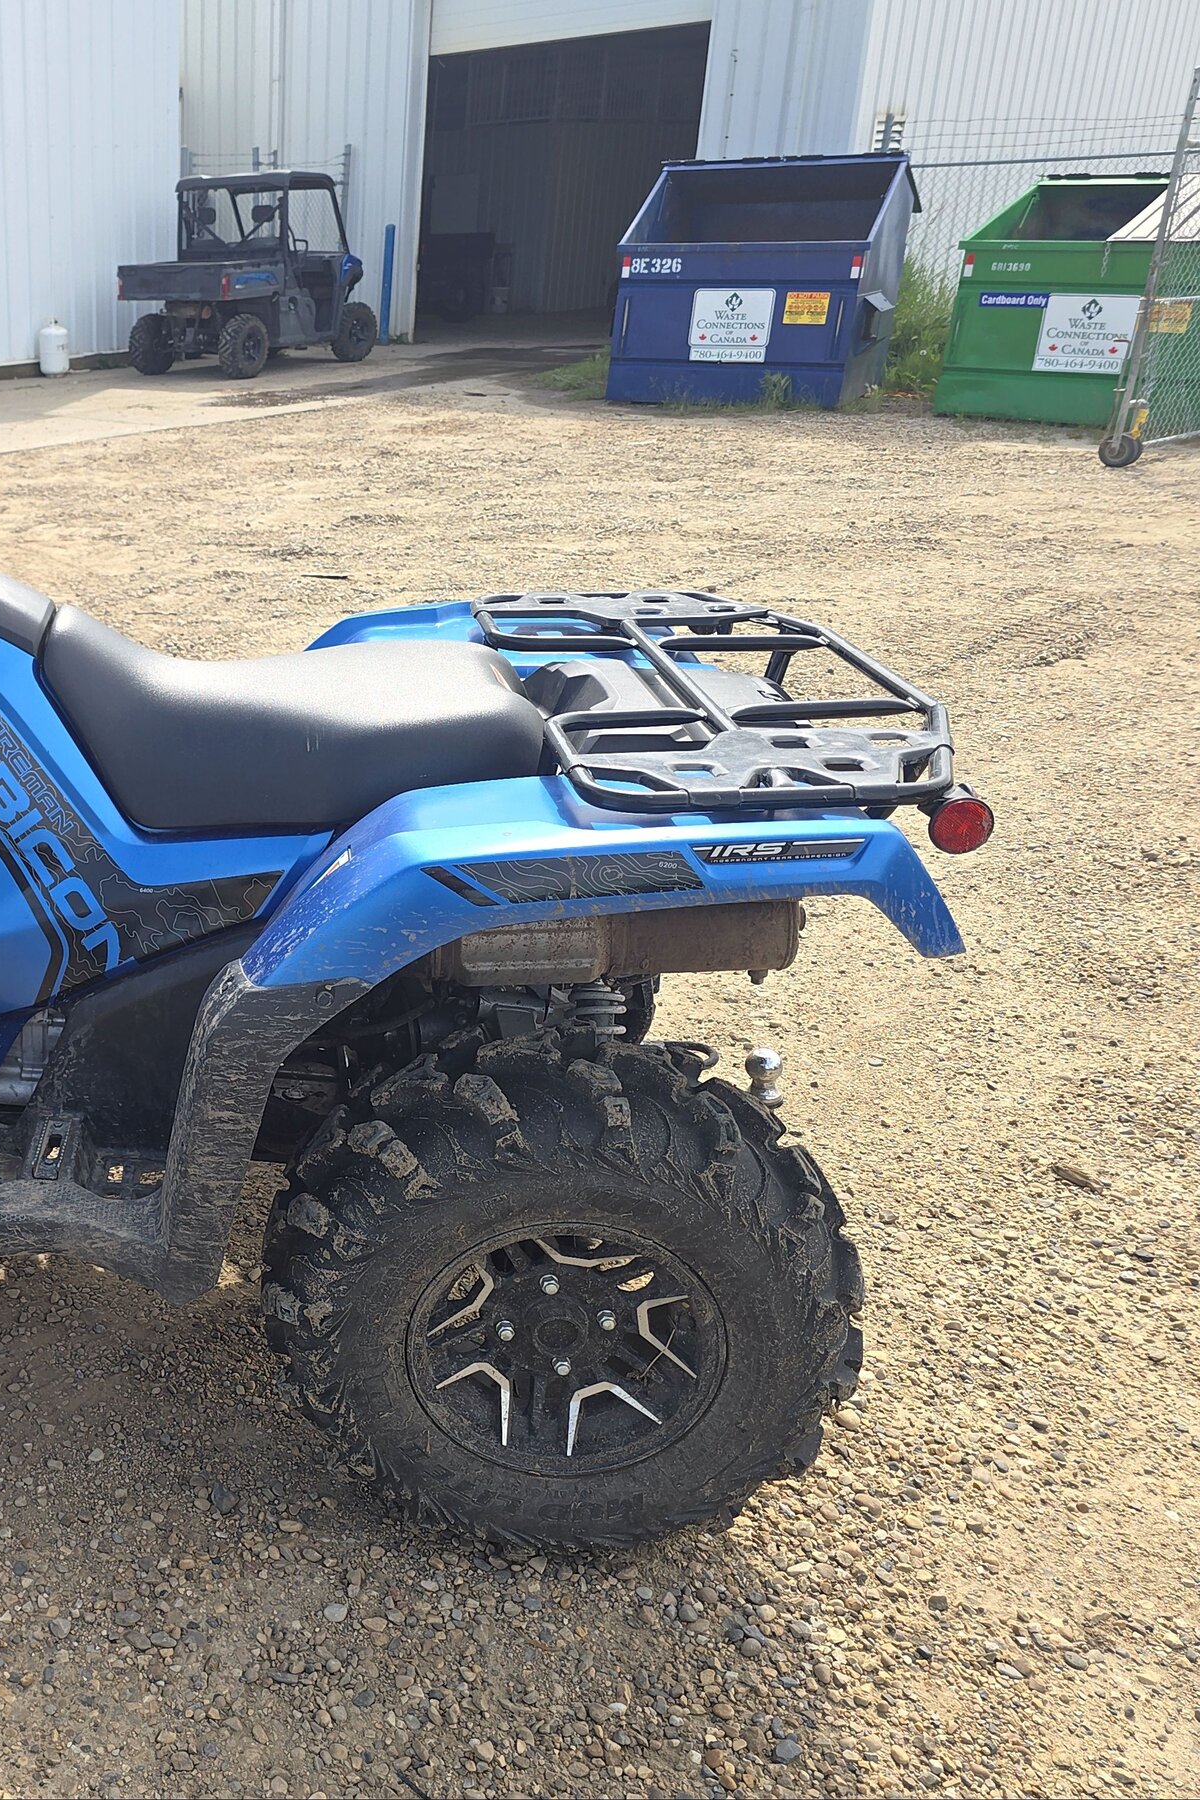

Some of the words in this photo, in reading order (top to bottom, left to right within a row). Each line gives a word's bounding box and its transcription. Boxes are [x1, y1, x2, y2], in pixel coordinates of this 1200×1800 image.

[631, 257, 682, 274] 8E326
[981, 295, 1025, 305] Cardboard
[1027, 295, 1047, 307] Only
[694, 350, 762, 360] 780-464-9400
[1038, 357, 1119, 370] 780-464-9400
[710, 842, 787, 858] IRS
[658, 861, 678, 870] 6200
